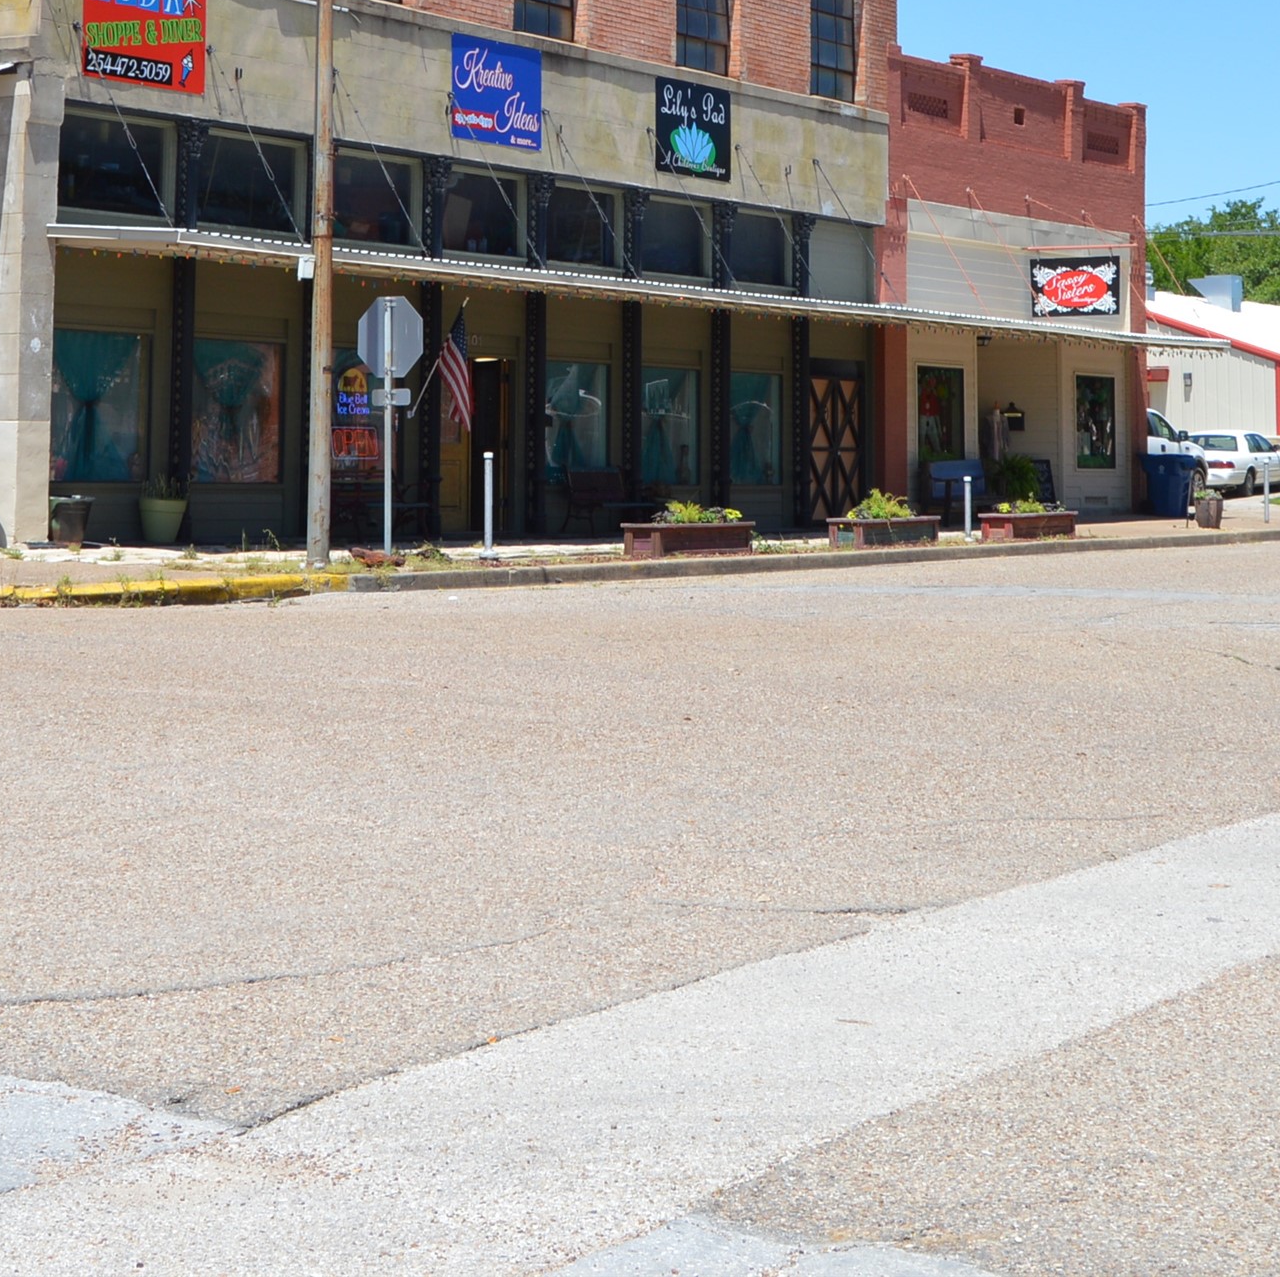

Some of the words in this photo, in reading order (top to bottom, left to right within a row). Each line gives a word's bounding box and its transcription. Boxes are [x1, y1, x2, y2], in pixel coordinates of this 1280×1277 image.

[86, 21, 140, 47] SHOPPE
[145, 20, 158, 45] &
[160, 18, 203, 44] DINER
[86, 54, 171, 82] 254-472-5059
[454, 47, 514, 93] Kreative
[494, 92, 539, 133] Ideas
[660, 84, 697, 128] Lily's
[702, 92, 725, 124] Pad
[1044, 273, 1089, 291] Sassy
[1052, 284, 1095, 302] Sisters
[337, 403, 348, 414] Ice
[349, 403, 370, 414] Cream
[339, 392, 354, 403] Blue
[355, 393, 368, 404] Bell
[334, 430, 378, 456] OPEN
